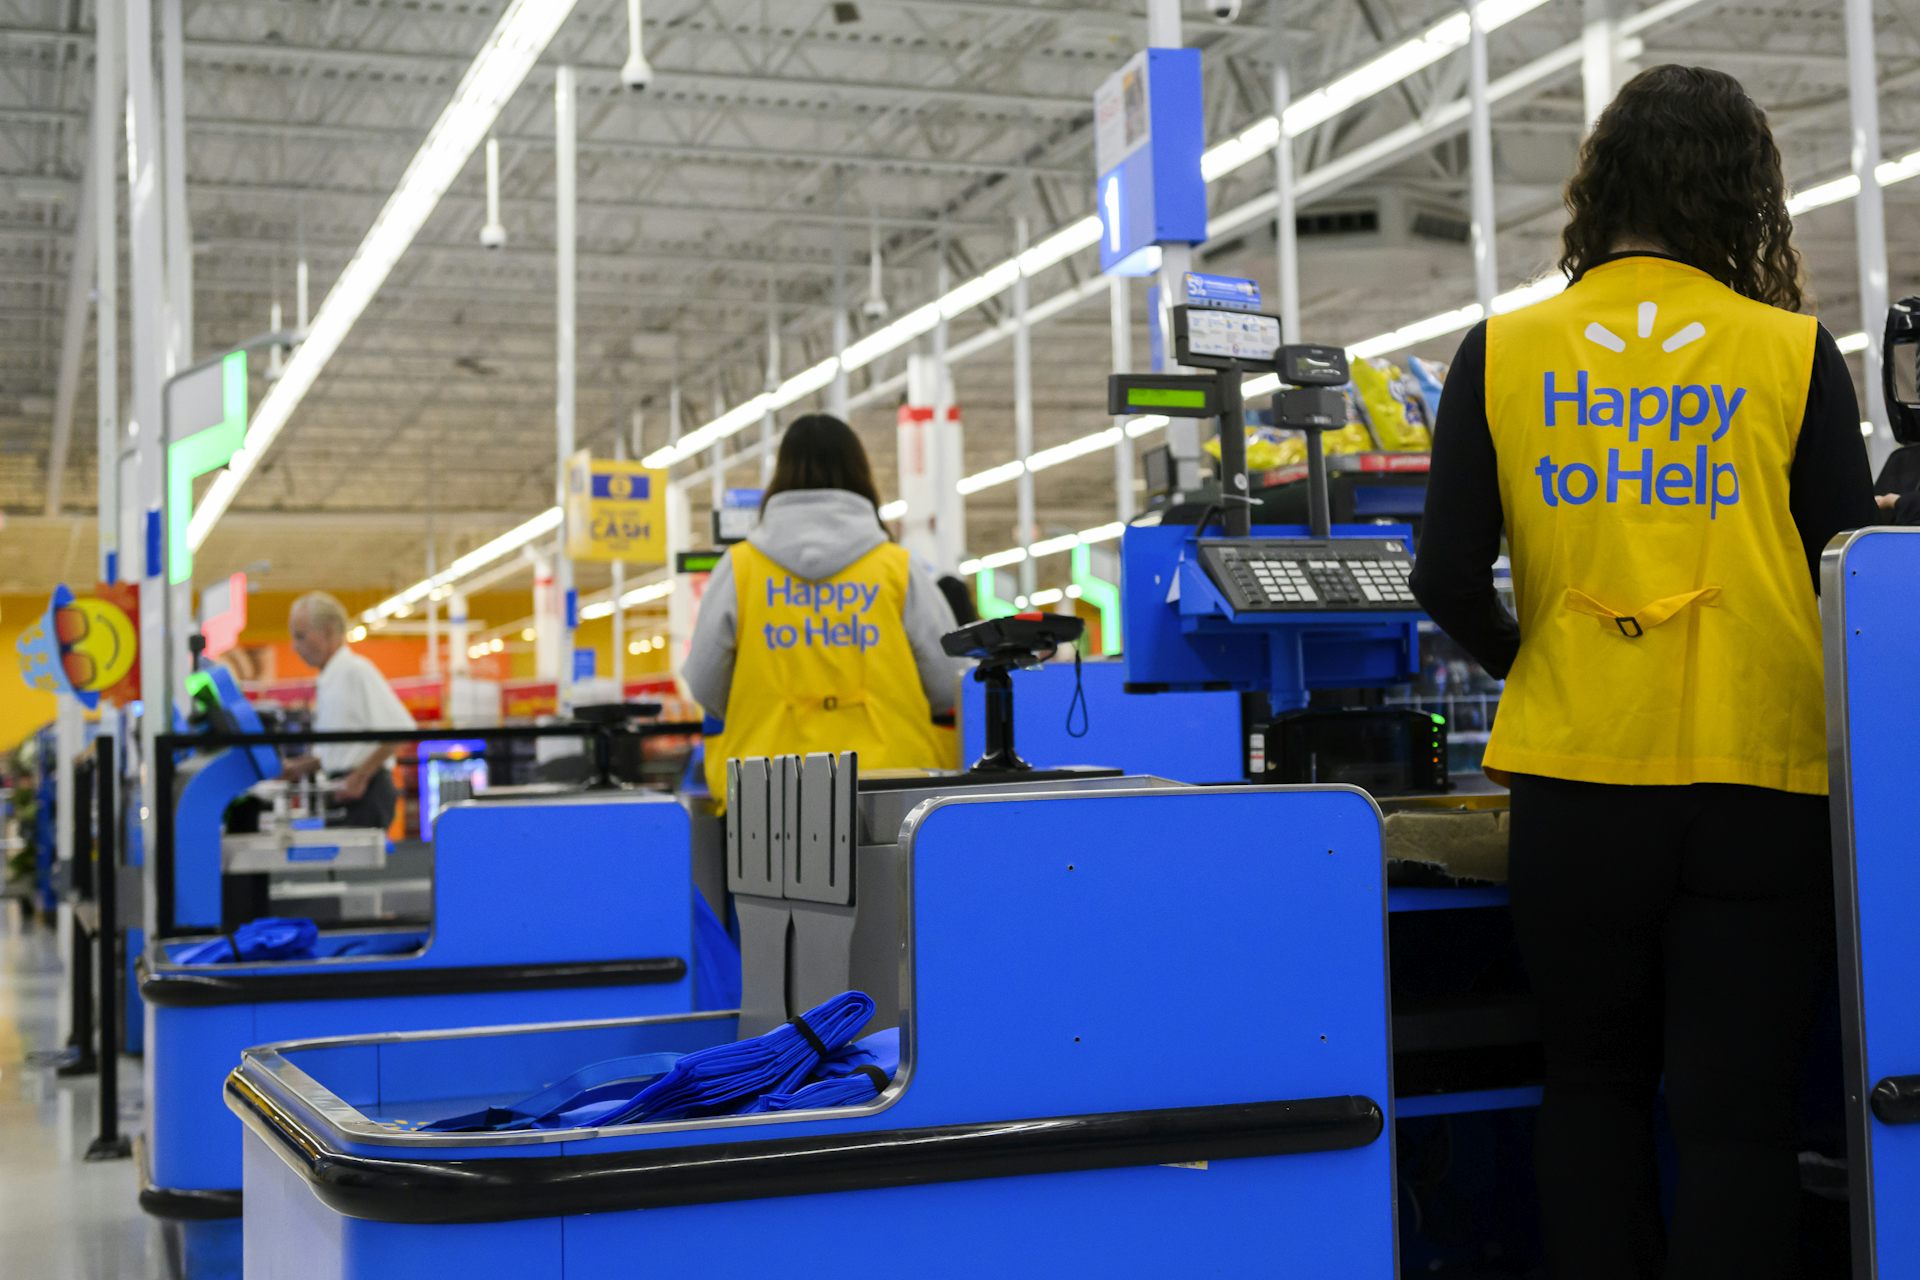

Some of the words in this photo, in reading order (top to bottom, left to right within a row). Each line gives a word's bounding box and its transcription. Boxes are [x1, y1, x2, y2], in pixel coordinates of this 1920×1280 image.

[1105, 176, 1121, 253] 1
[1544, 370, 1747, 442] Happy
[1535, 455, 1598, 507] to
[1606, 445, 1740, 520] Help
[766, 576, 880, 613] Happy
[763, 622, 798, 650] to
[805, 613, 880, 653] Help
